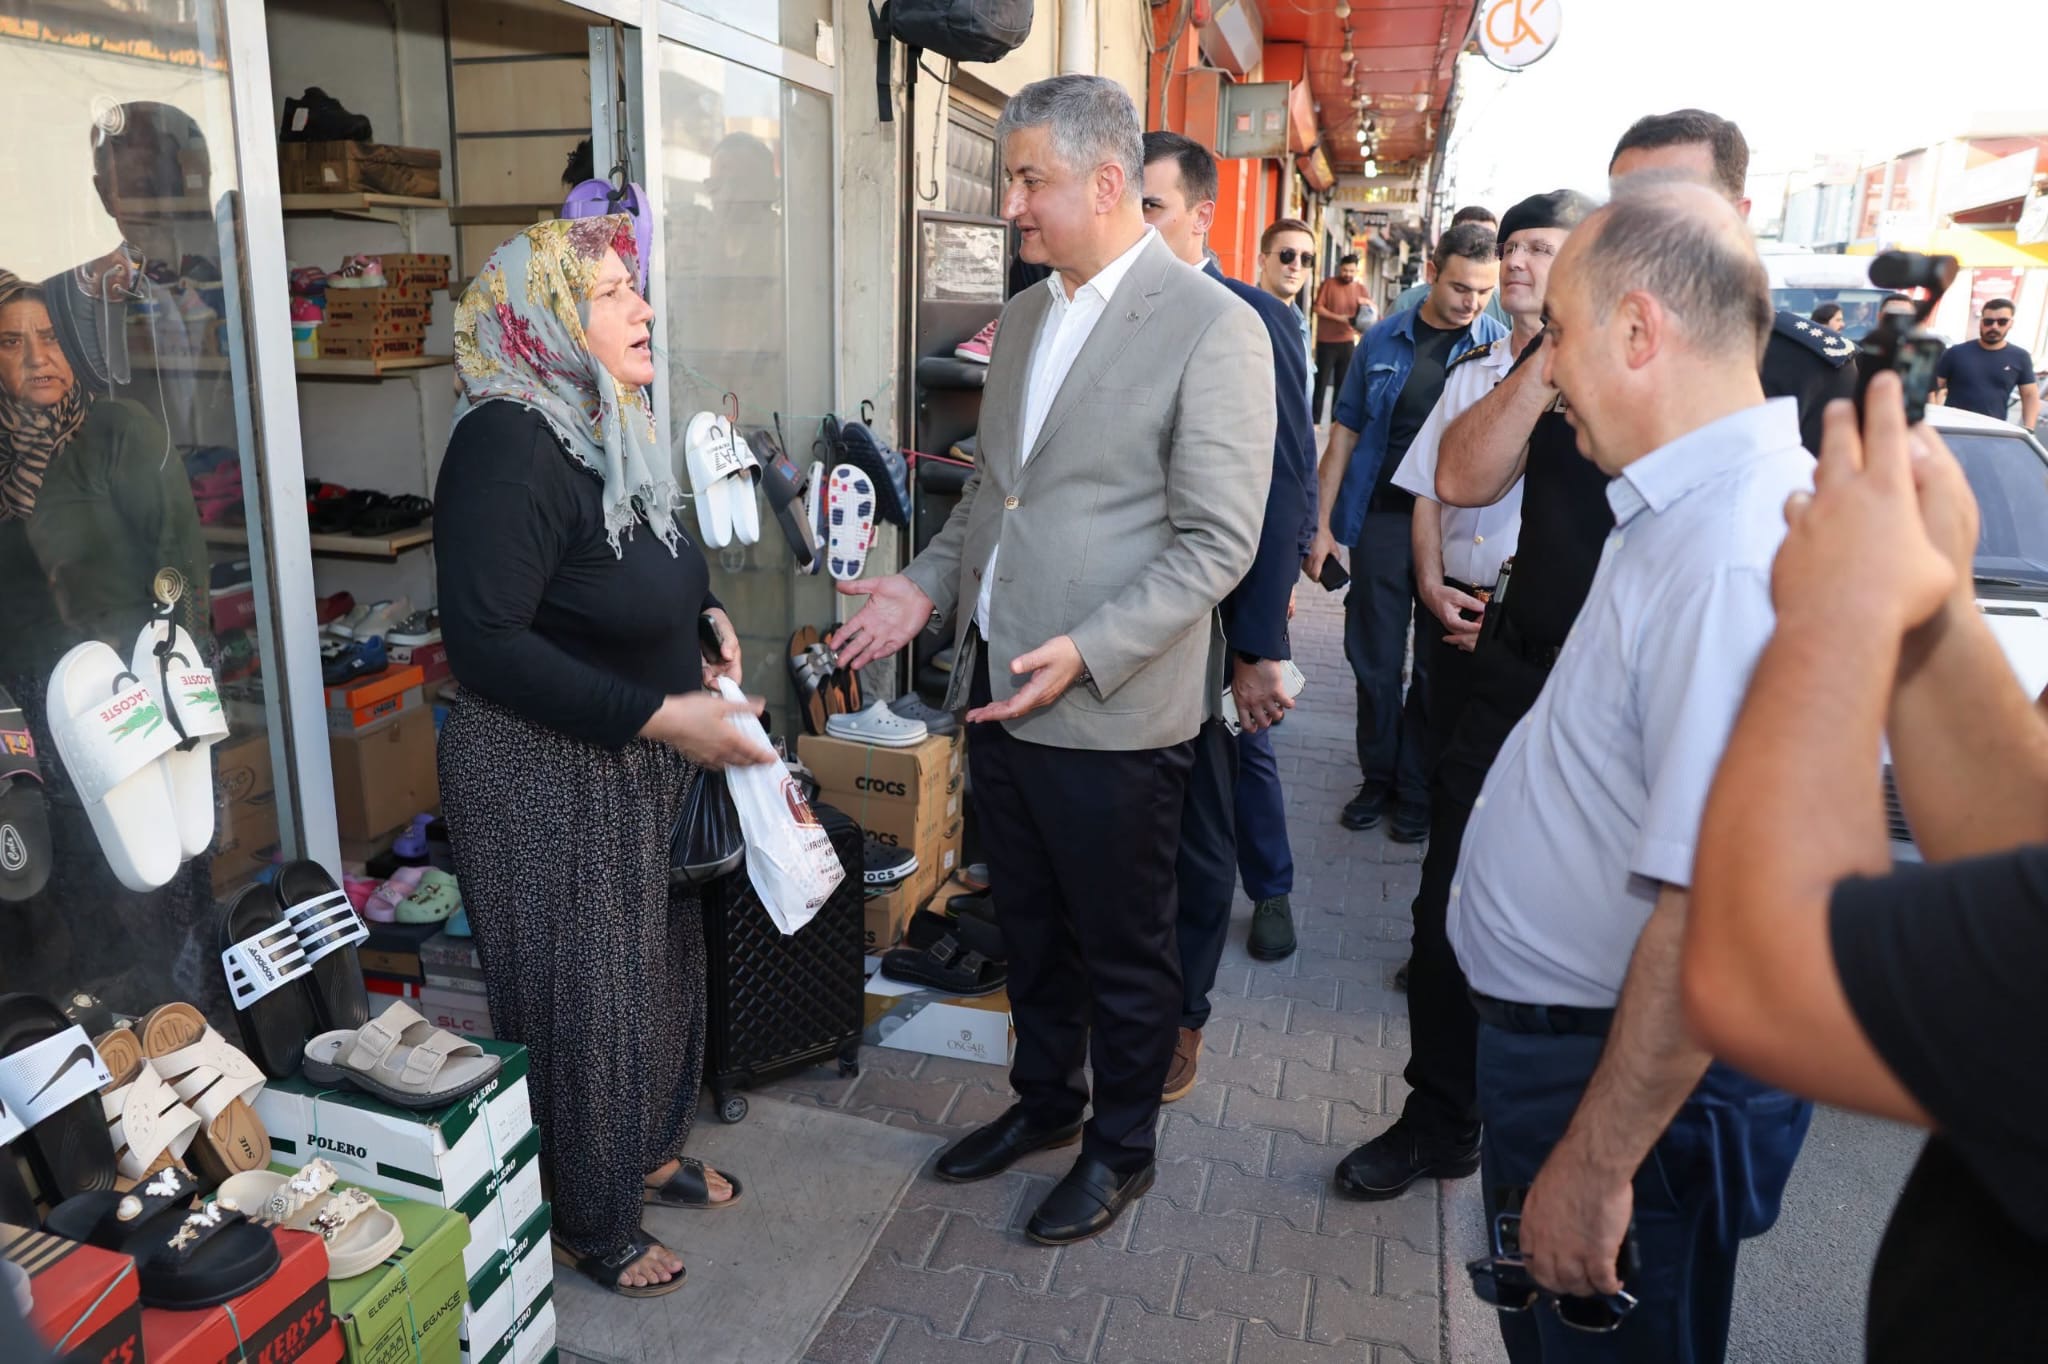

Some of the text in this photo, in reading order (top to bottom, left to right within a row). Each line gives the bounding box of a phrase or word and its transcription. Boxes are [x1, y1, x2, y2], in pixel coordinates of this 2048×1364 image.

[100, 688, 149, 722] LACOSTE
[854, 775, 906, 797] crocs
[254, 953, 275, 982] adidas
[437, 1015, 476, 1031] SLC
[467, 1078, 499, 1115] POLERO
[307, 1133, 367, 1159] POLERO
[485, 1158, 516, 1195] POLERO
[498, 1237, 529, 1275] POLERO
[368, 1275, 408, 1319] ELEGANCE
[411, 1290, 461, 1345] ELEGANCE
[503, 1307, 532, 1347] POLERO
